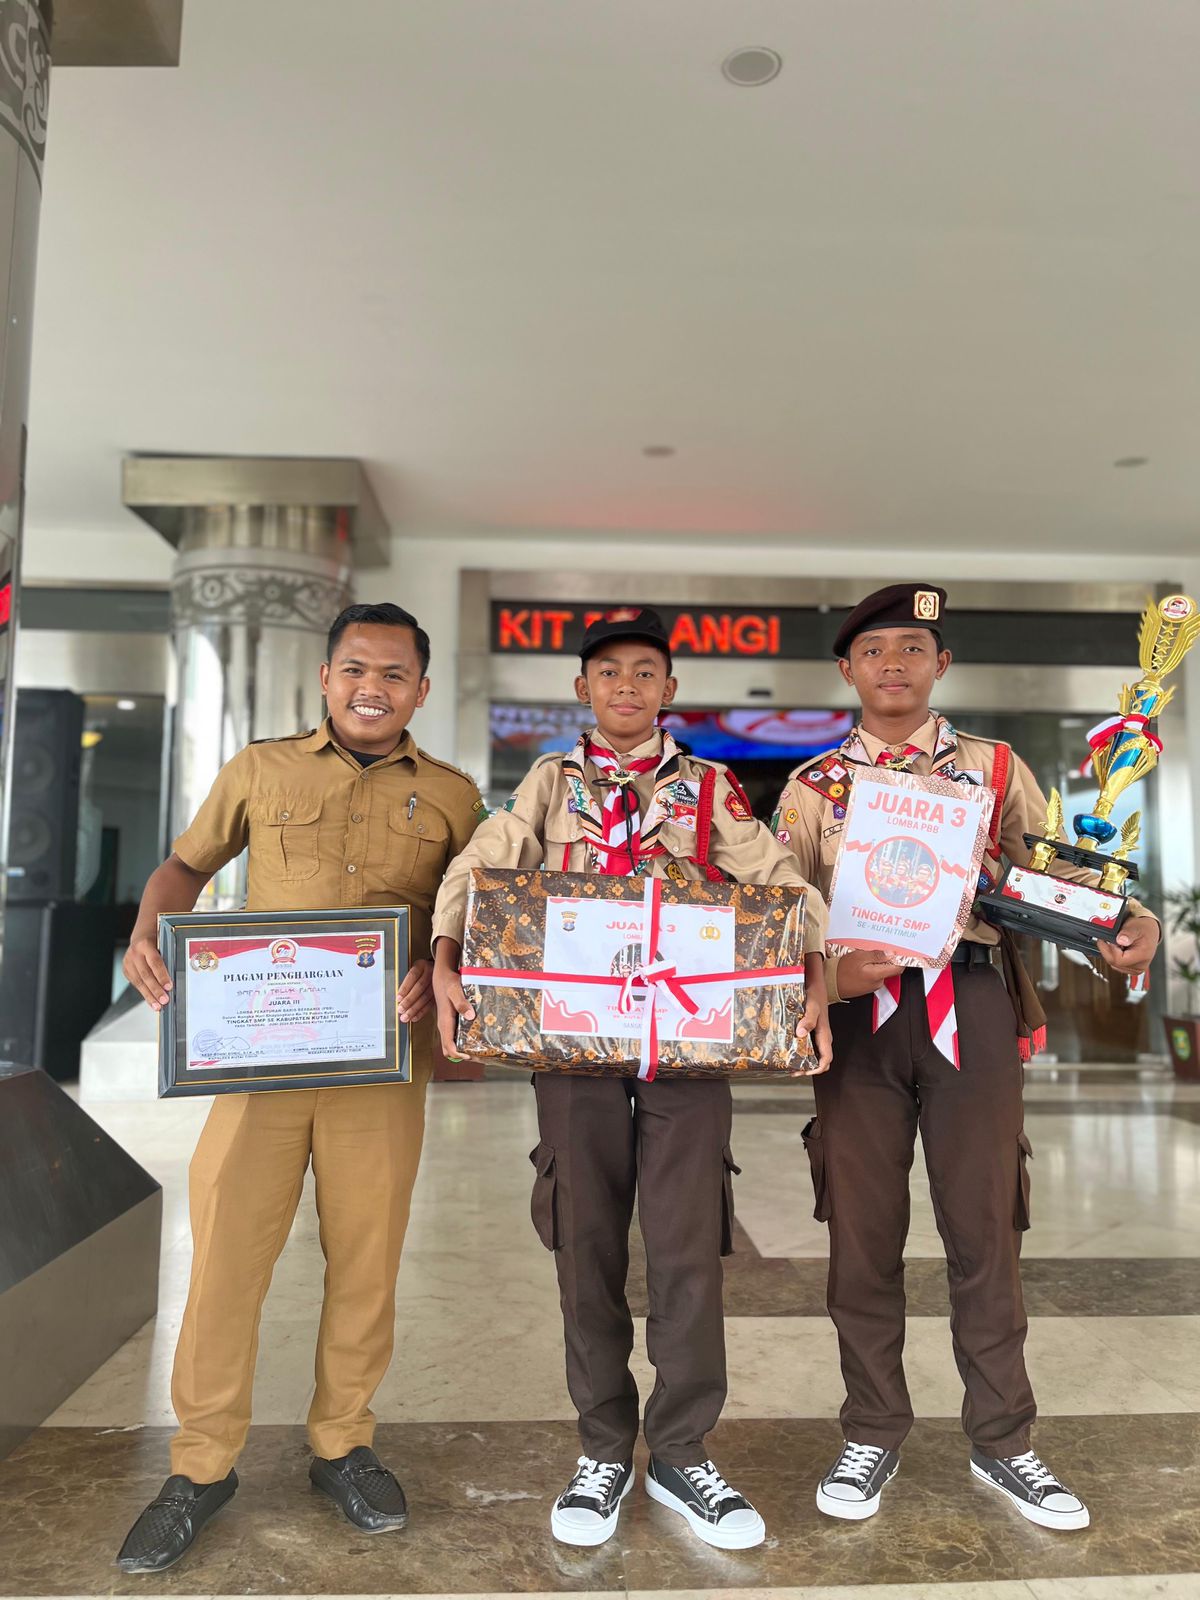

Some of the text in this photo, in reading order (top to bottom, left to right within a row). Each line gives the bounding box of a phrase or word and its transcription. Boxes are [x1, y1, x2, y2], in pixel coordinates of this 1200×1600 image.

[499, 608, 573, 649] KIT
[868, 791, 967, 828] JUARA 3
[887, 816, 939, 833] LOMBA PBB
[606, 921, 677, 932] JUA 3
[851, 906, 931, 931] TINGKAT SMP
[856, 920, 866, 928] SE
[871, 924, 892, 934] KUTAI
[894, 928, 917, 939] TIMUR
[223, 969, 344, 982] PIAGAM PENGHARGAAN
